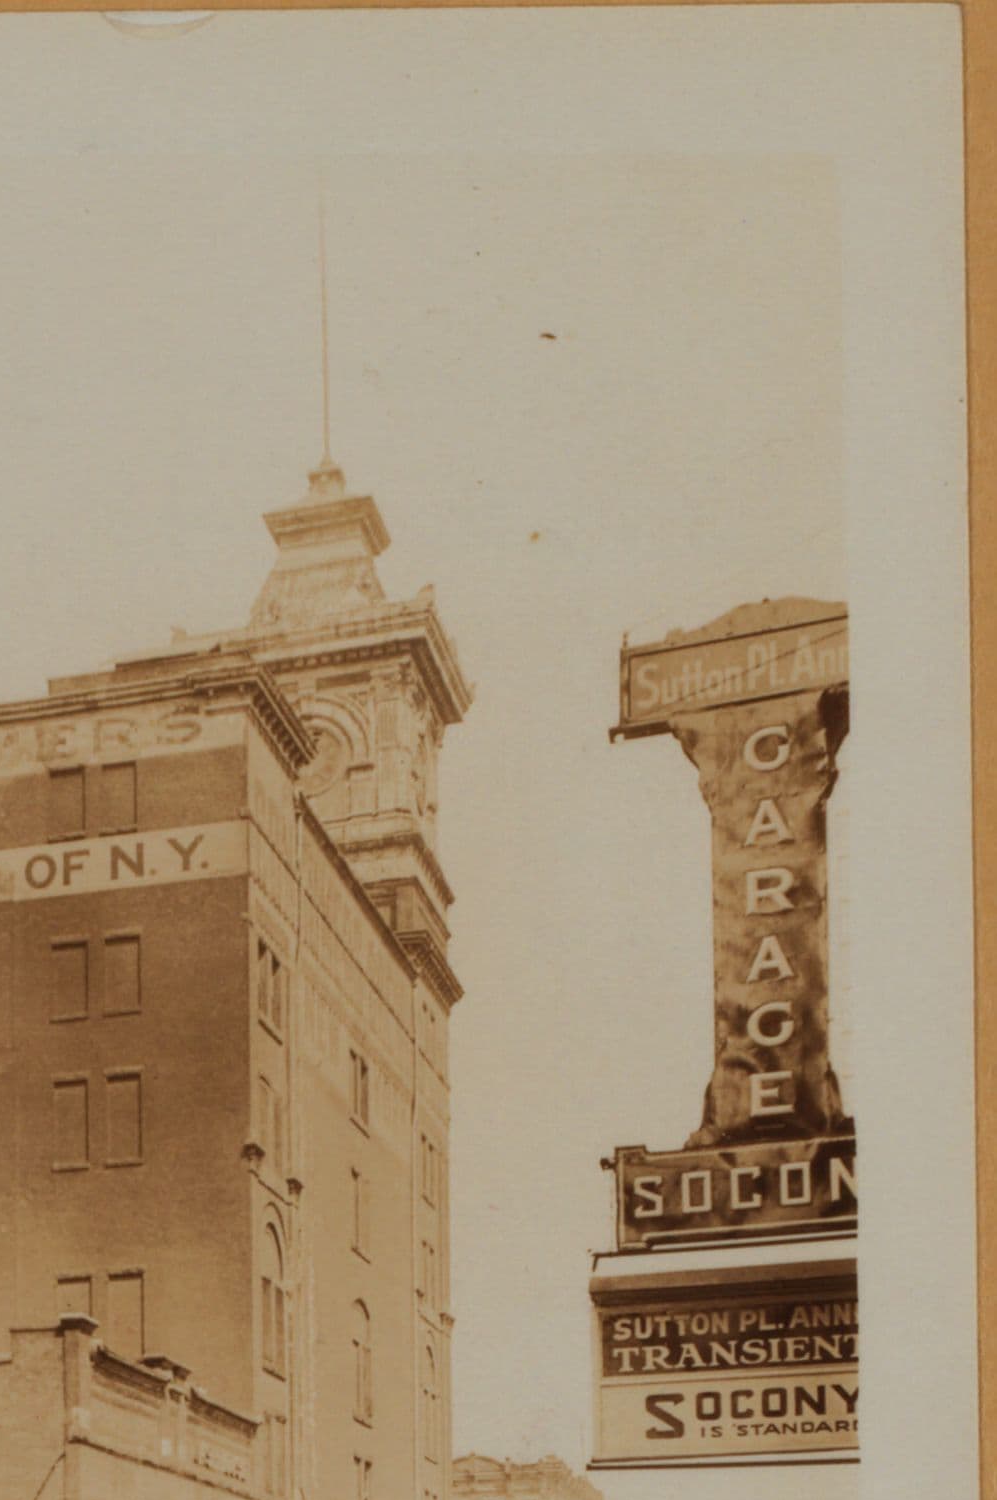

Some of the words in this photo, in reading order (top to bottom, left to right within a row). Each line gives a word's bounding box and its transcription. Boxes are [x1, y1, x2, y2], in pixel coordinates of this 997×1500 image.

[636, 658, 743, 709] Sutton
[24, 849, 91, 889] OF
[743, 725, 795, 1117] GARAGE
[612, 1311, 730, 1341] SUTTON
[739, 1309, 784, 1333] PL.
[645, 1384, 859, 1440] SOCONY
[700, 1425, 723, 1438] IS
